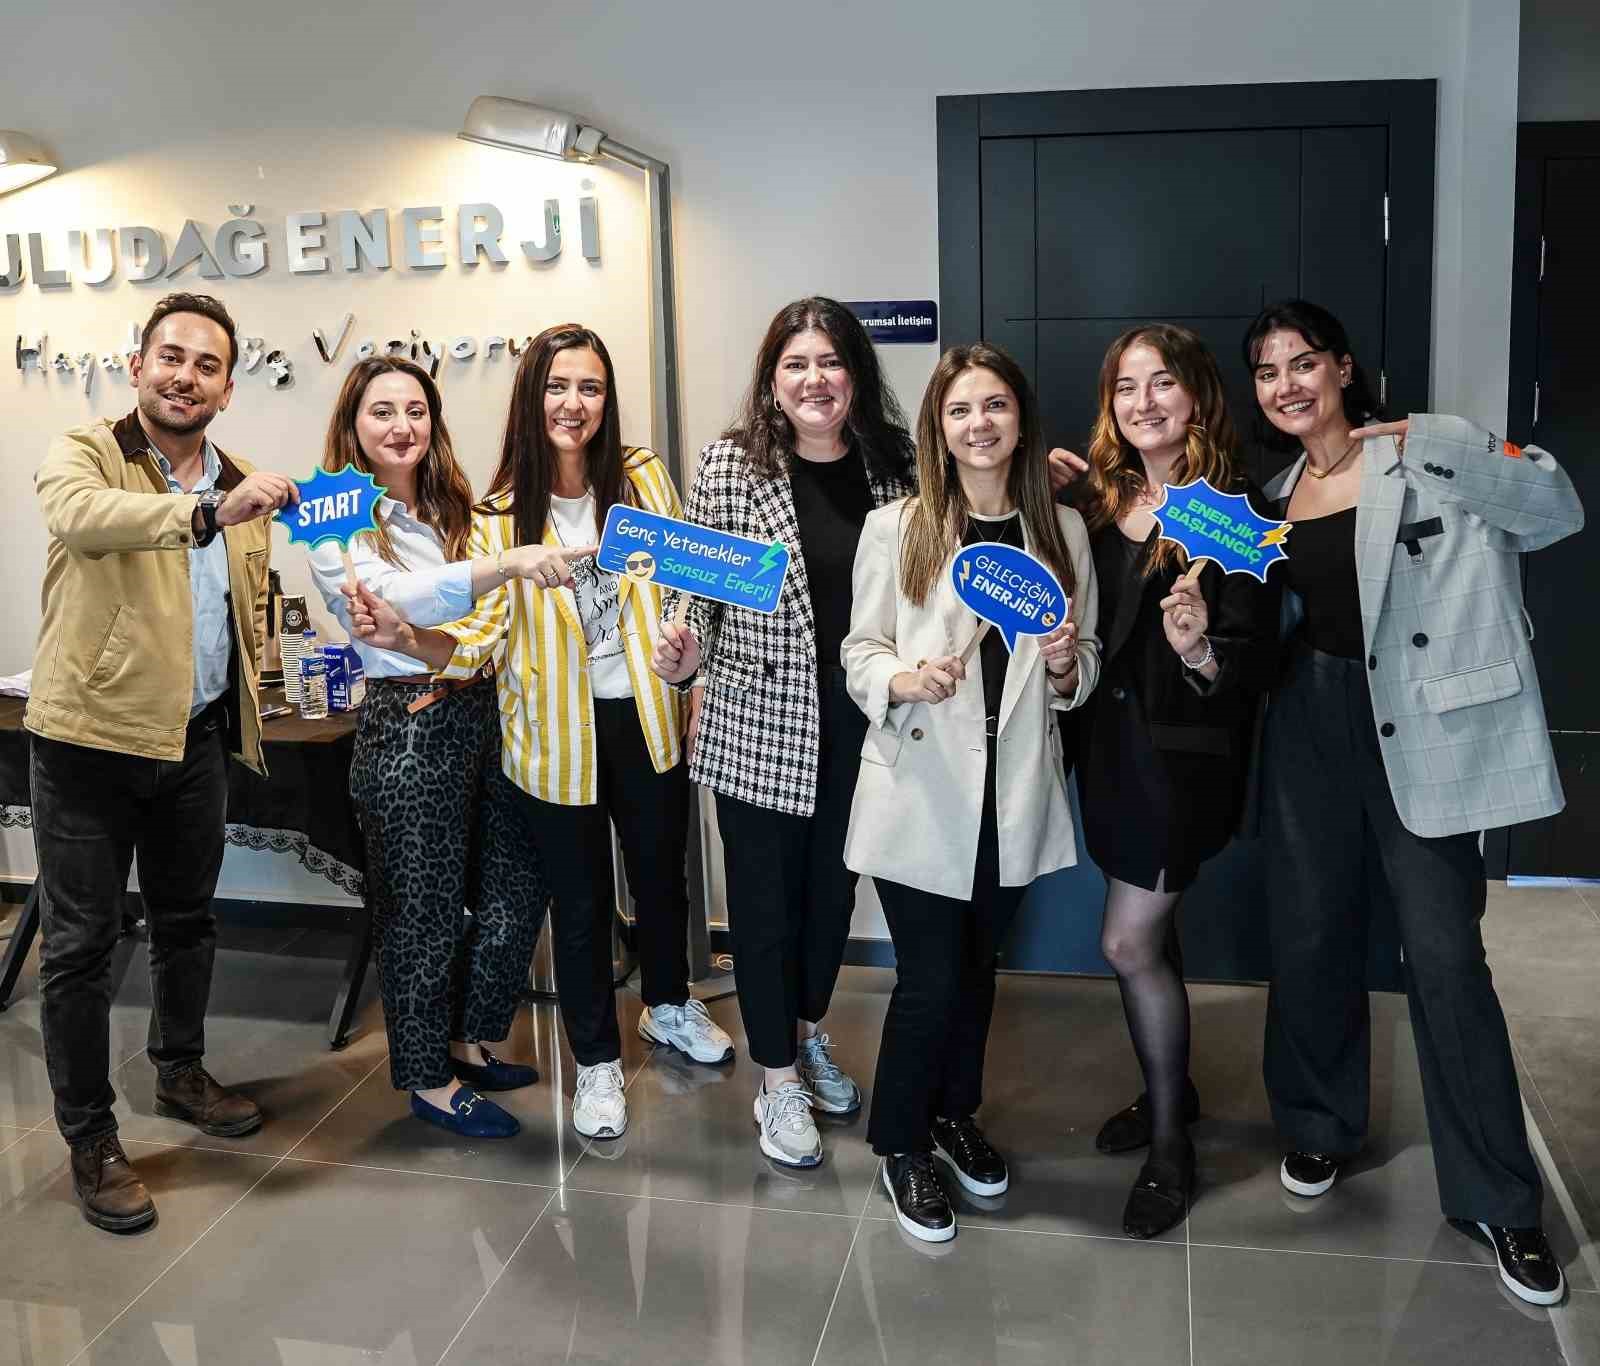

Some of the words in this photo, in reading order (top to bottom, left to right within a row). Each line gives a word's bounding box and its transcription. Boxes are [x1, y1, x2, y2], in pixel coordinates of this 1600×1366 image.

[286, 178, 601, 274] ENERJİ
[857, 316, 896, 327] urumsal
[897, 314, 933, 327] İletişim
[297, 488, 362, 527] START
[1187, 498, 1258, 542] ENERJİK
[616, 519, 658, 545] Genç
[663, 529, 752, 567] Yetenekler
[659, 558, 719, 584] Sonsuz
[724, 572, 776, 603] Enerji
[971, 574, 1041, 620] ENERJİSİ
[975, 555, 1057, 609] GELECEĞİN
